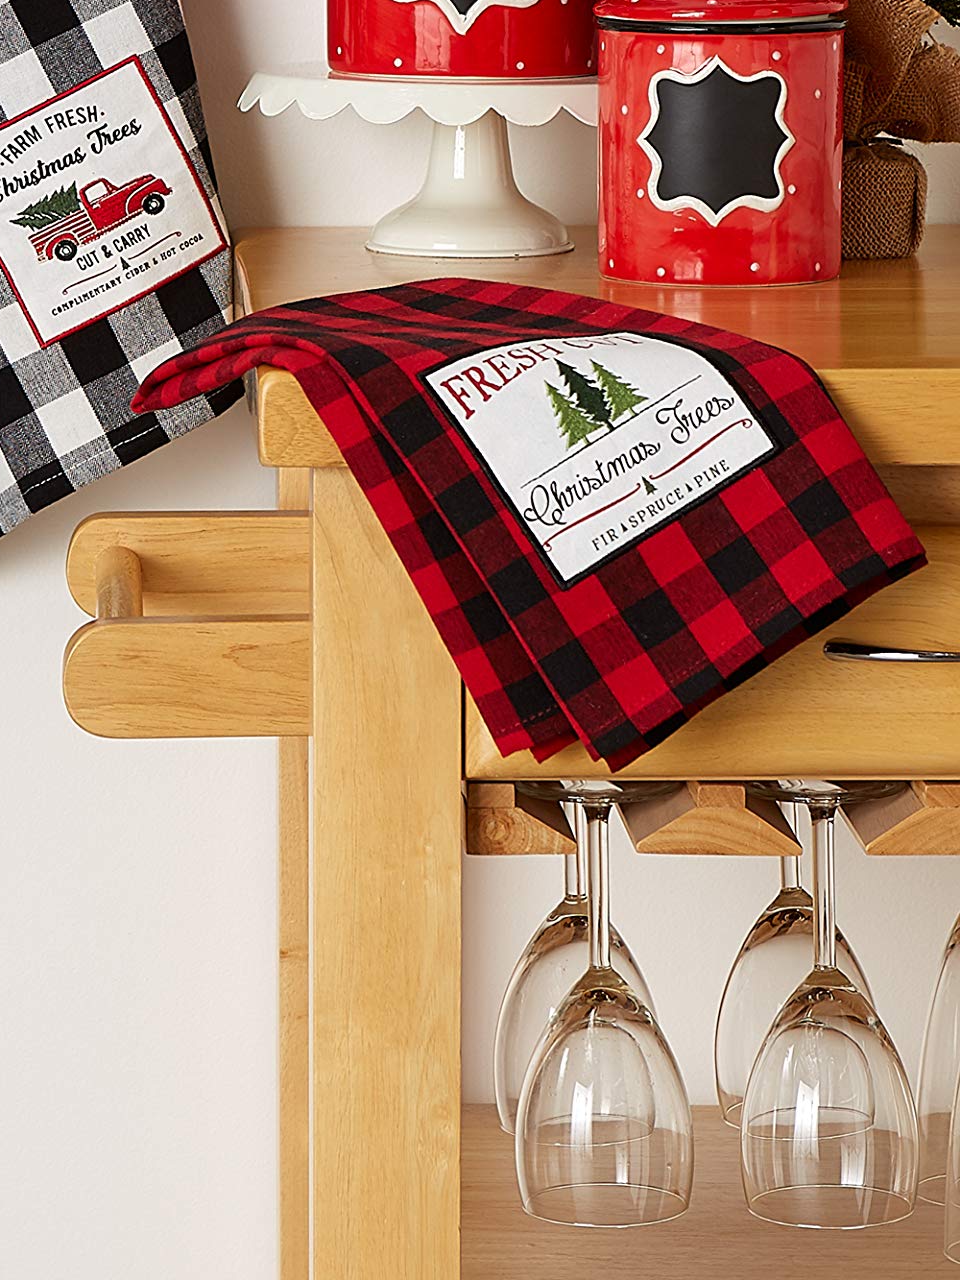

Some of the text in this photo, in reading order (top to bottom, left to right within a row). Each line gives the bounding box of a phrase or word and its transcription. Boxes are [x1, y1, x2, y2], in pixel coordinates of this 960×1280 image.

[0, 105, 98, 164] FARM FRESH
[86, 118, 142, 154] Trees
[51, 233, 204, 316] COMPLIMENTARY CIDER & HOT COCOA
[76, 223, 152, 271] CUT & CARRY
[440, 343, 564, 420] FRESH
[523, 397, 736, 526] Christmas Trees
[591, 459, 731, 551] FIR SPRUCE PINE
